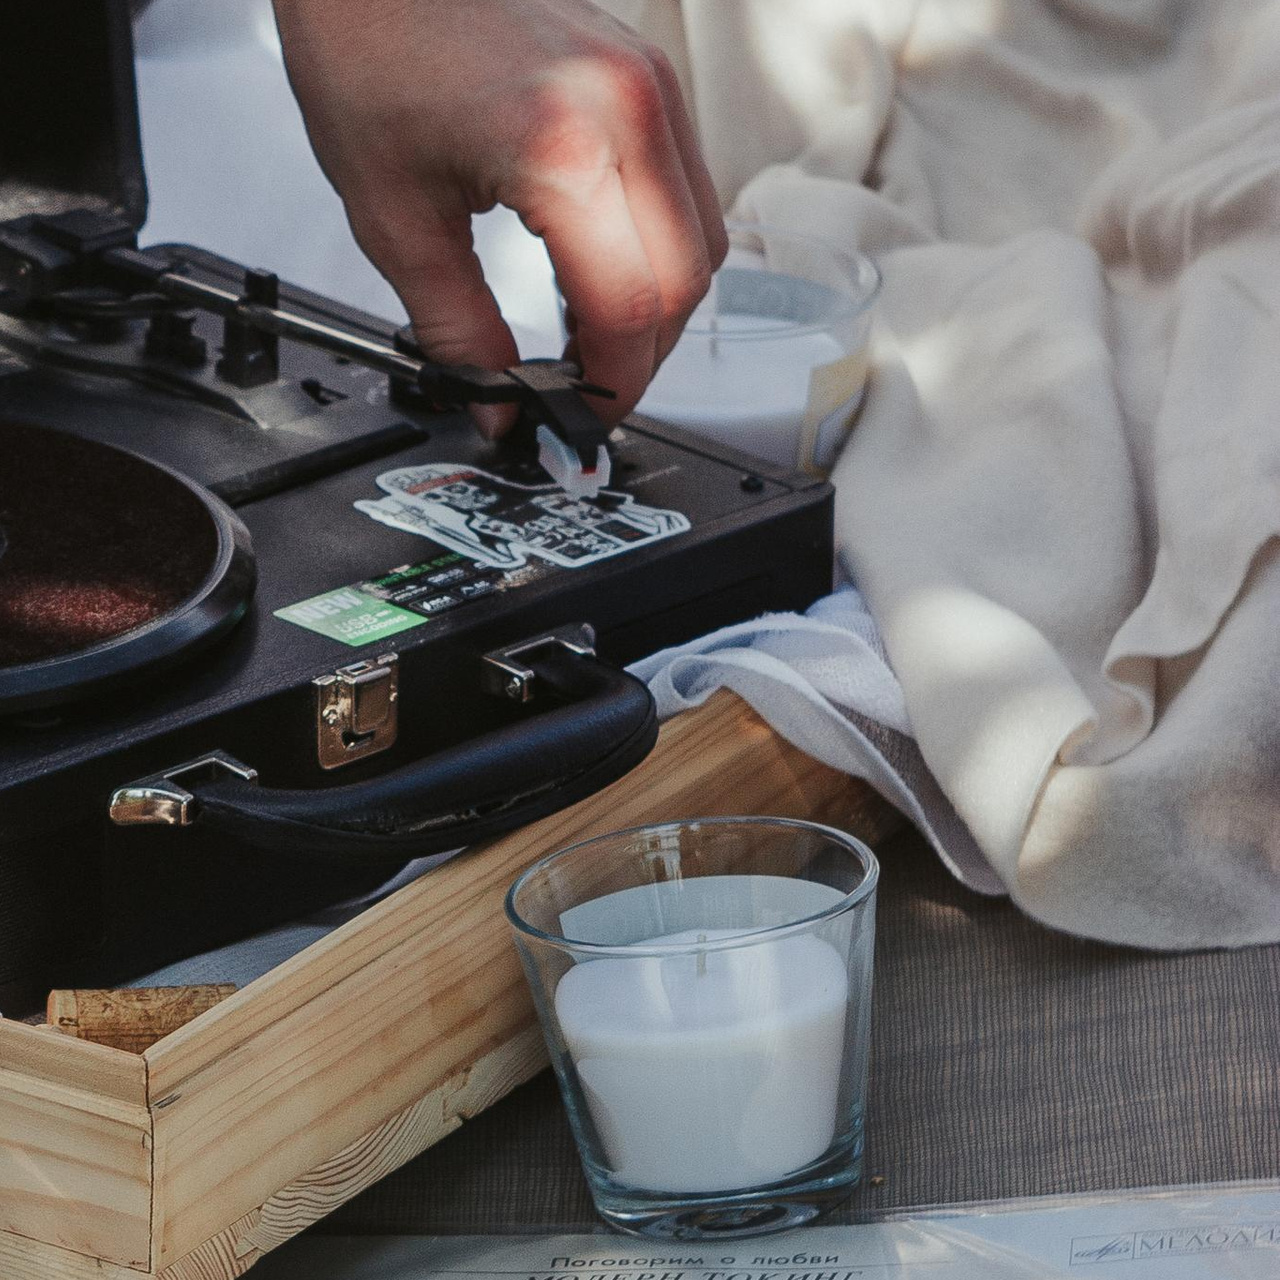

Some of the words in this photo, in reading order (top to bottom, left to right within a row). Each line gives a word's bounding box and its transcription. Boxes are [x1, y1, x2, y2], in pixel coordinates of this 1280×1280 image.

[288, 591, 364, 622] NEW
[1140, 1226, 1280, 1252] МЕЛОДИ
[549, 1256, 705, 1269] Поговорим
[720, 1256, 737, 1266] о
[751, 1252, 841, 1266] любви
